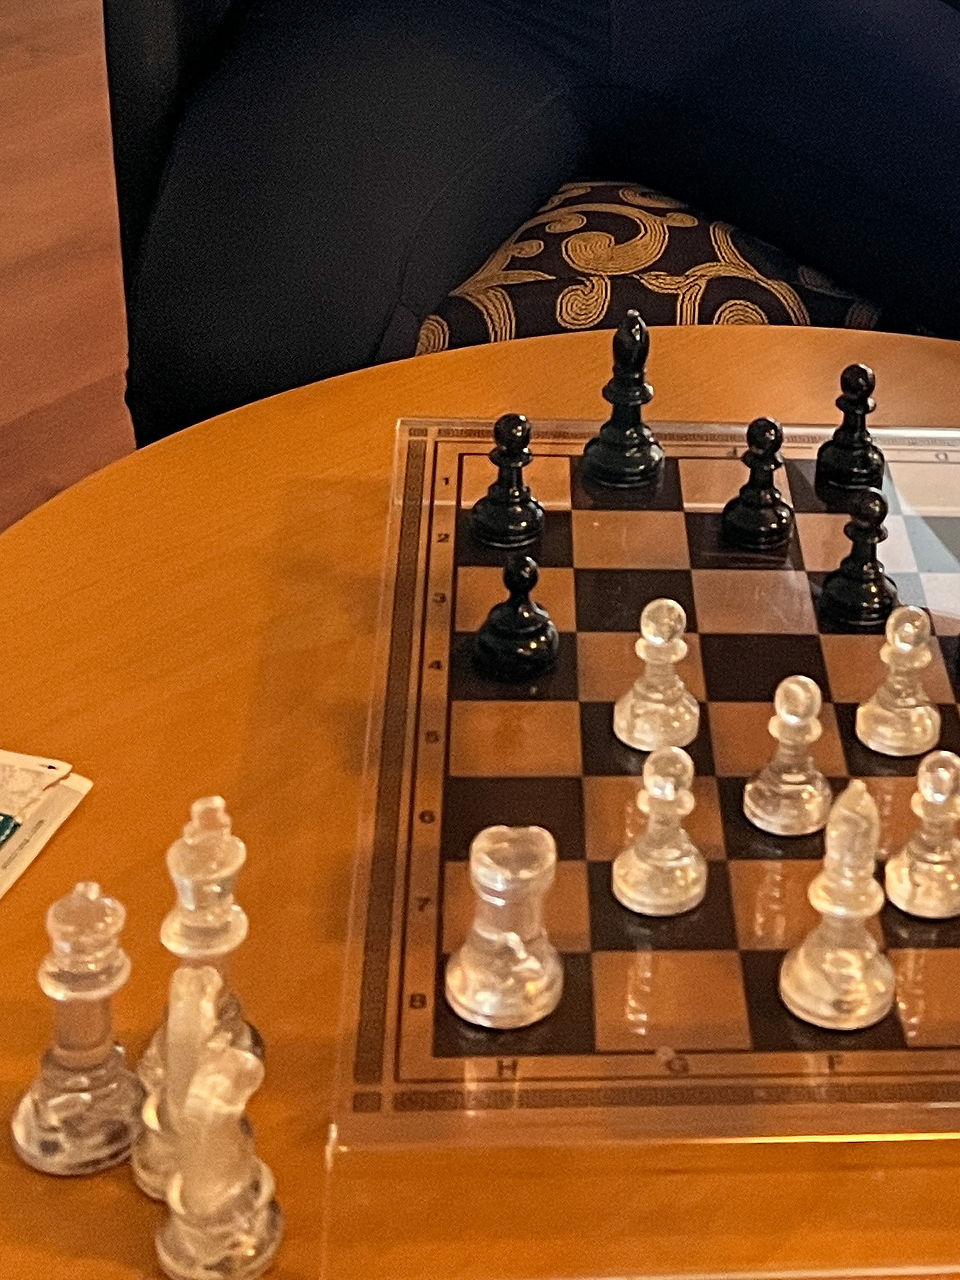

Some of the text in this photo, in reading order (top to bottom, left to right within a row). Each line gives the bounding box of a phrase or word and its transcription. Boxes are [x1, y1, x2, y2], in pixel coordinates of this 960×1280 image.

[438, 533, 449, 542] 2
[428, 660, 442, 670] 4
[419, 809, 435, 824] 6
[417, 897, 432, 912] 7
[497, 1058, 518, 1076] H
